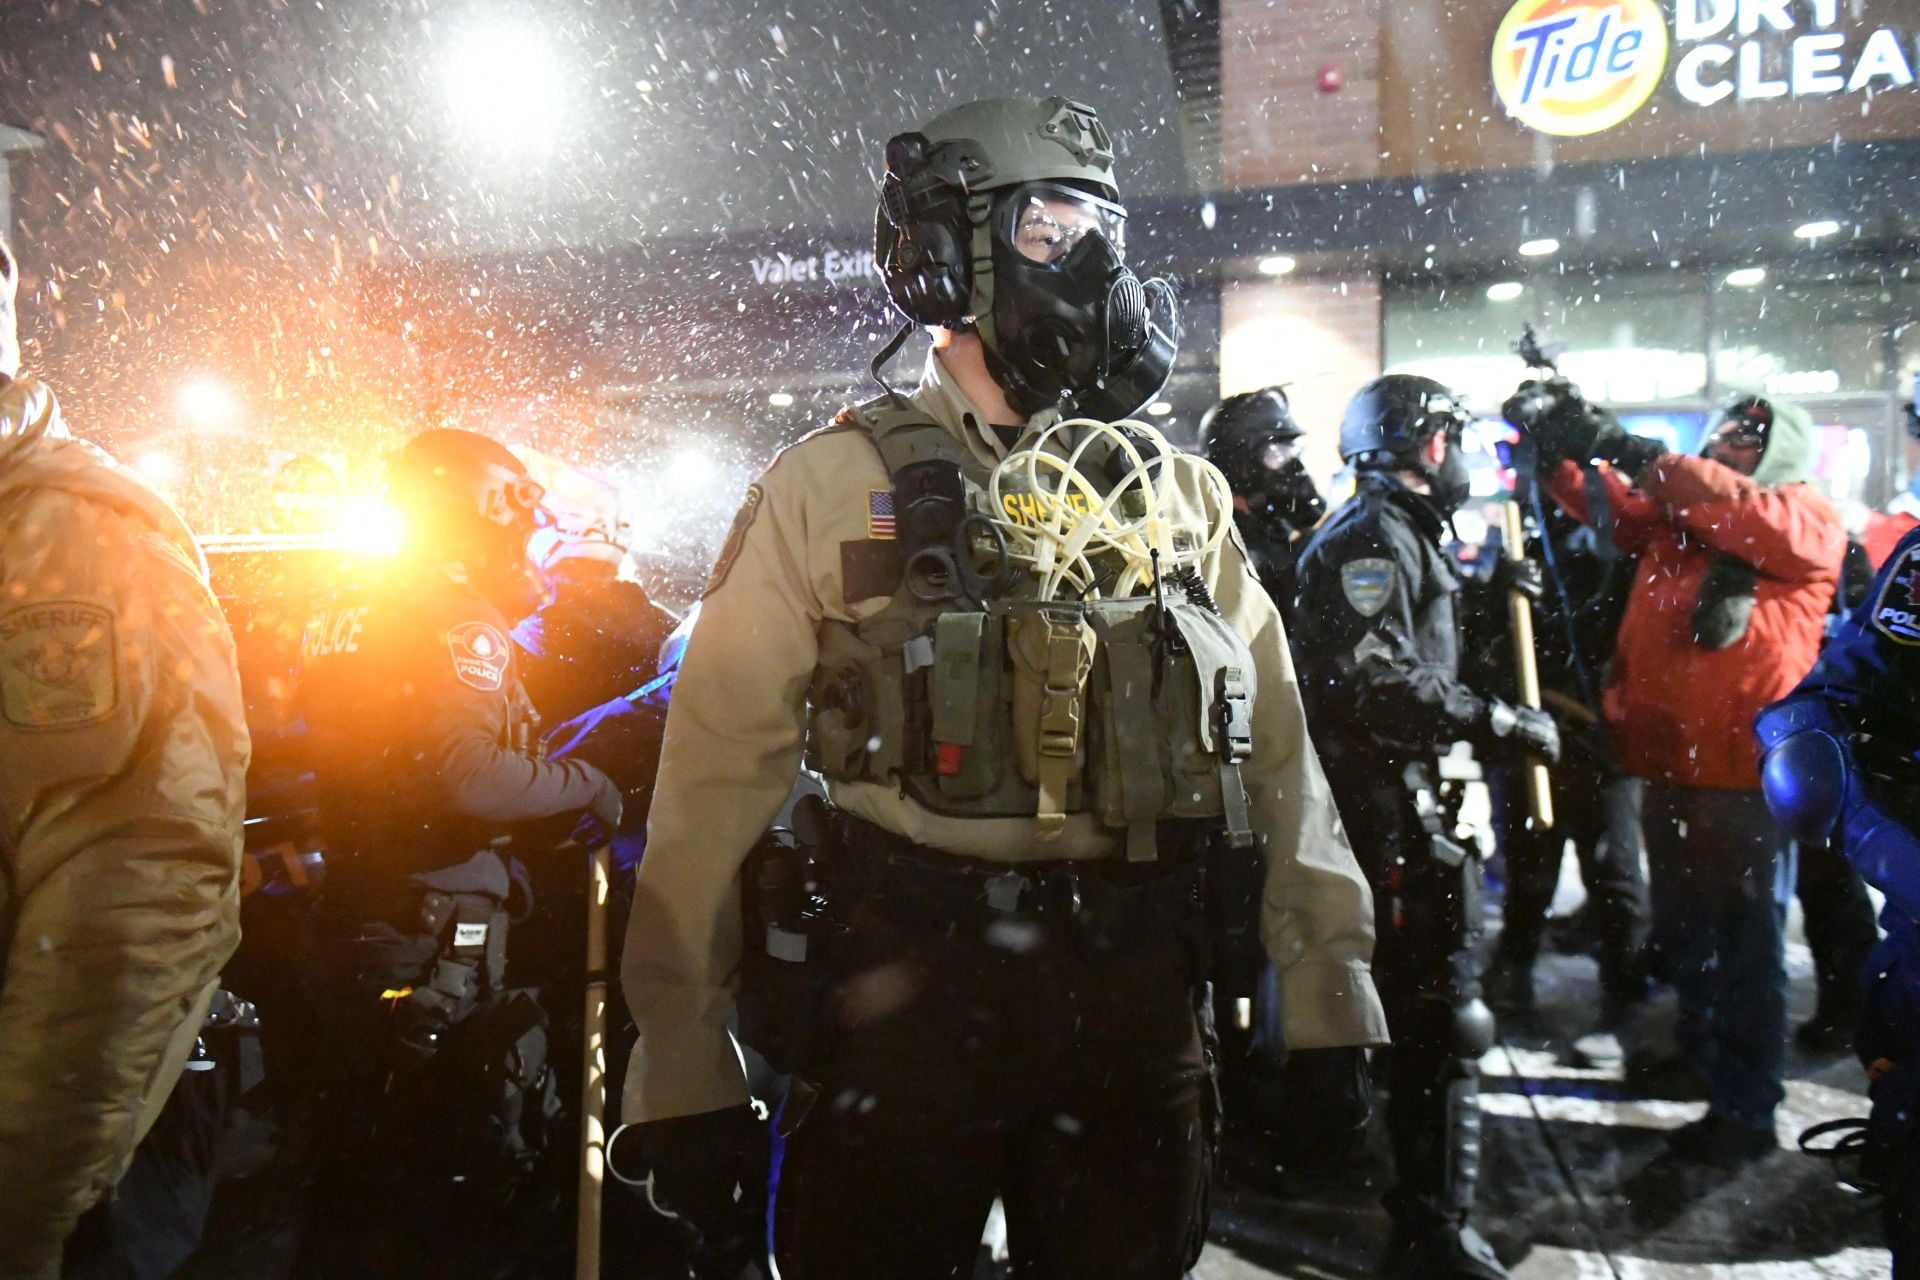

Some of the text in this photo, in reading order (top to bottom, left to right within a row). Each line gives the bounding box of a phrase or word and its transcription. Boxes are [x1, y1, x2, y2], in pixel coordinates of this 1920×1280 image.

[1515, 14, 1643, 105] Tide
[1675, 30, 1920, 107] CLEA
[751, 249, 874, 285] Valet Exit
[460, 664, 498, 682] POLICE
